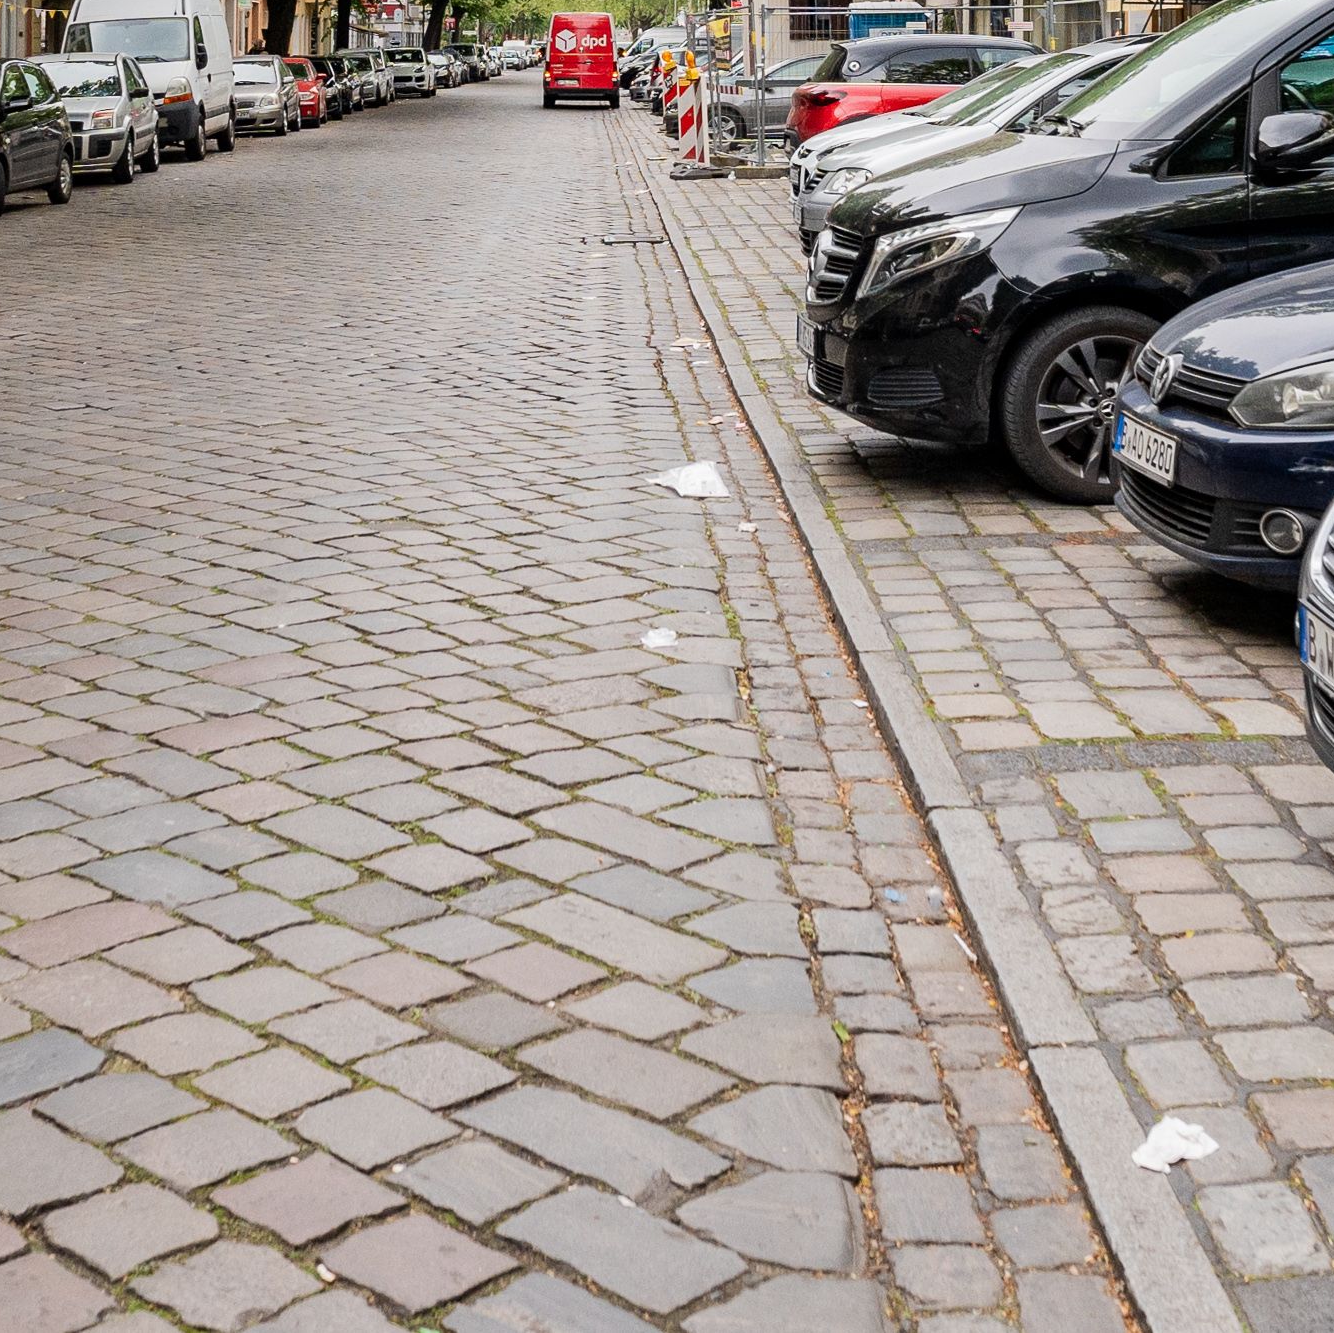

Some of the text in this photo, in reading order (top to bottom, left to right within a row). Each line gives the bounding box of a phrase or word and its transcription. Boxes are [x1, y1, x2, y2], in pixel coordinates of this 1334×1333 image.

[581, 33, 607, 50] dpd
[1145, 435, 1173, 474] 6280
[1308, 618, 1317, 664] B
